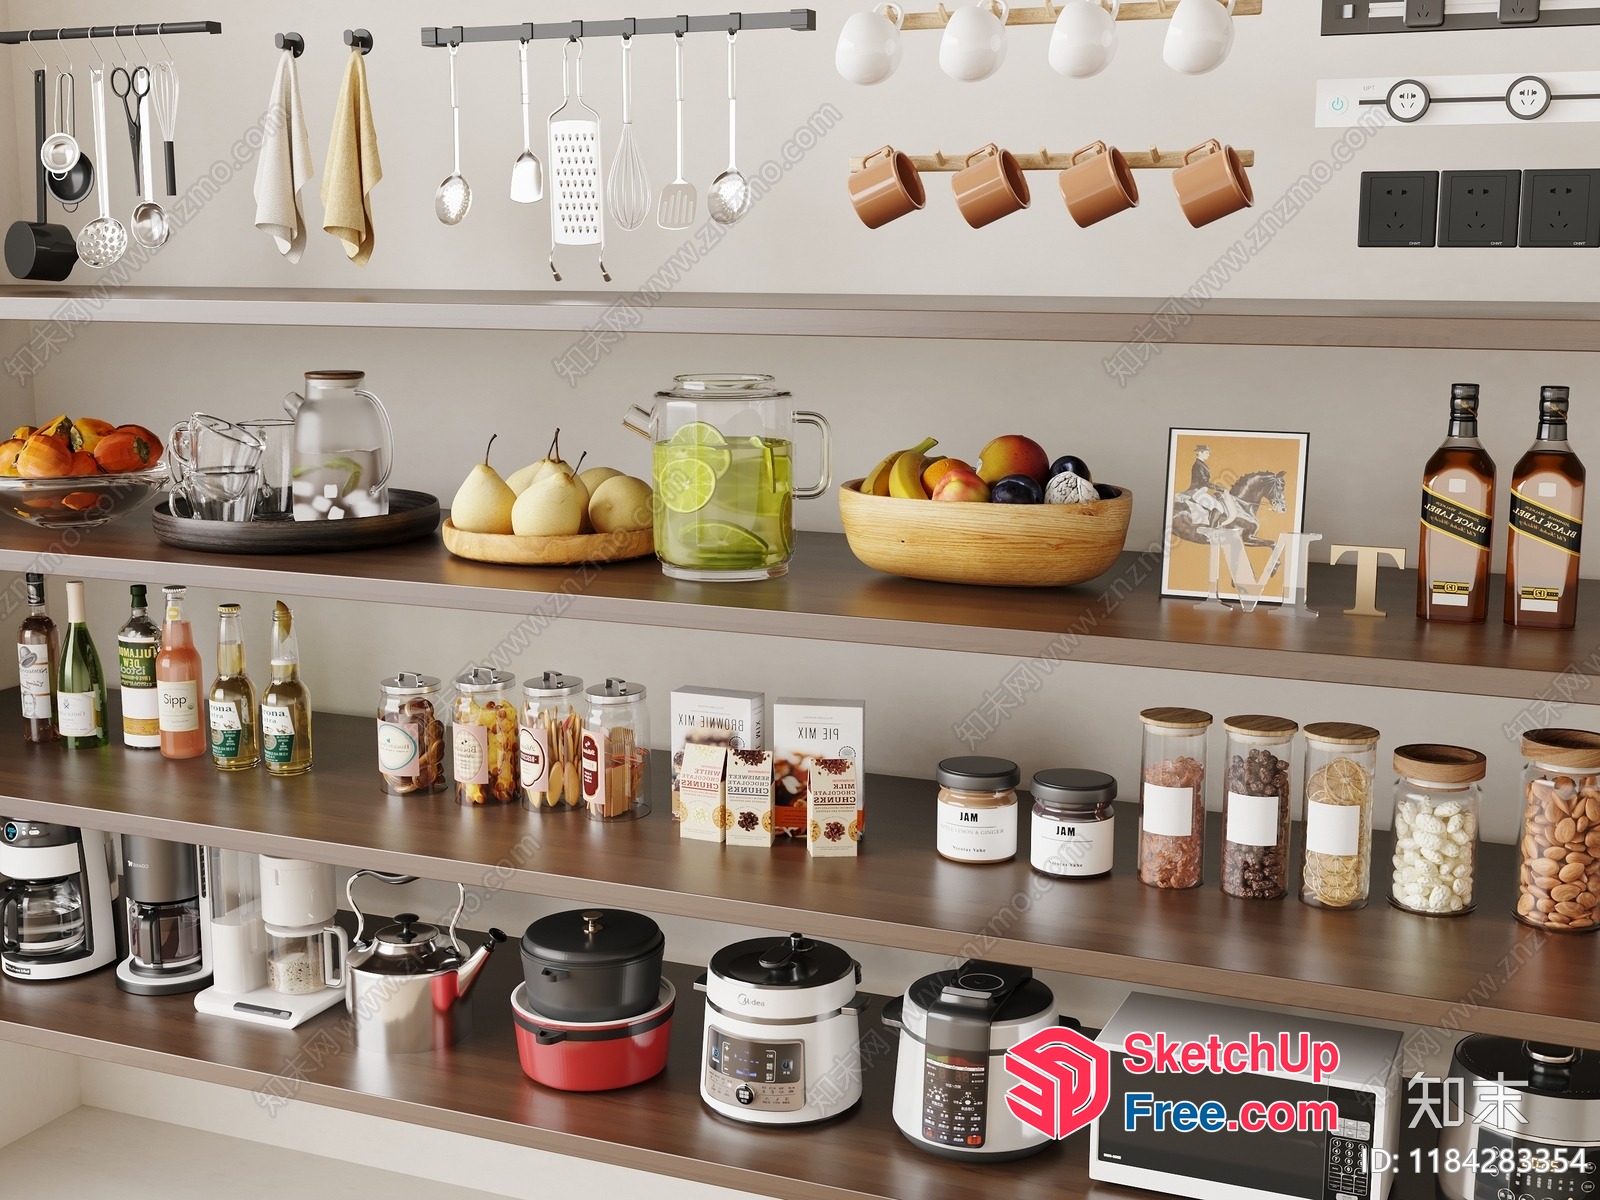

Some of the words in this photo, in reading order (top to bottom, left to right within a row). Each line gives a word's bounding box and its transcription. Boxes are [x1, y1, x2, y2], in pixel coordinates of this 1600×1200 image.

[1193, 527, 1323, 618] M
[1330, 544, 1406, 617] T
[163, 693, 187, 709] Sipp
[959, 811, 979, 823] JAM
[980, 828, 1005, 836] GINGER
[1056, 825, 1076, 837] JAM
